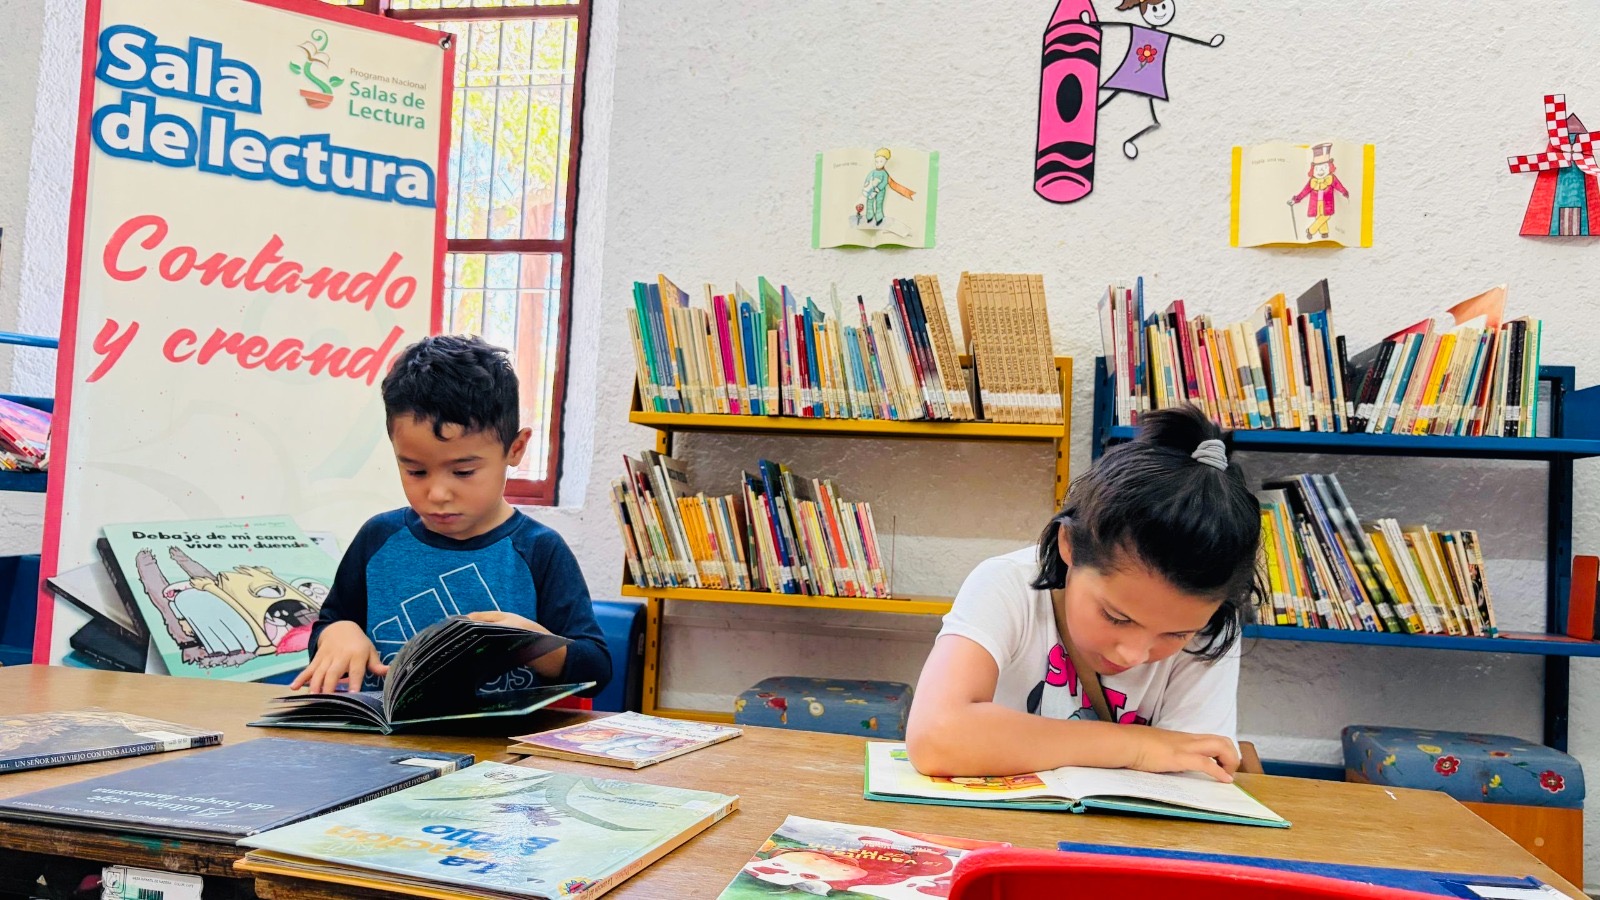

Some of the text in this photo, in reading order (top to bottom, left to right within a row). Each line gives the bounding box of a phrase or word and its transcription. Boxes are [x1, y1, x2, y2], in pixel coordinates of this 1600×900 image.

[103, 30, 254, 107] Sala
[350, 67, 427, 91] Programa Nacional
[350, 81, 425, 110] Salas de
[349, 99, 425, 129] Lectura
[97, 98, 432, 203] de lectura
[103, 214, 417, 311] Contando
[85, 318, 140, 383] y
[132, 531, 202, 543] Debajo
[206, 532, 227, 540] de
[231, 532, 251, 540] mi
[185, 540, 224, 549] vive
[253, 541, 309, 549] duende
[15, 760, 26, 768] UN
[27, 757, 50, 766] SEÑOR
[51, 755, 66, 763] MUY
[67, 752, 86, 762] VIEJO
[86, 750, 102, 759] CON
[102, 748, 120, 757] UNAS
[120, 746, 136, 755] ALAS
